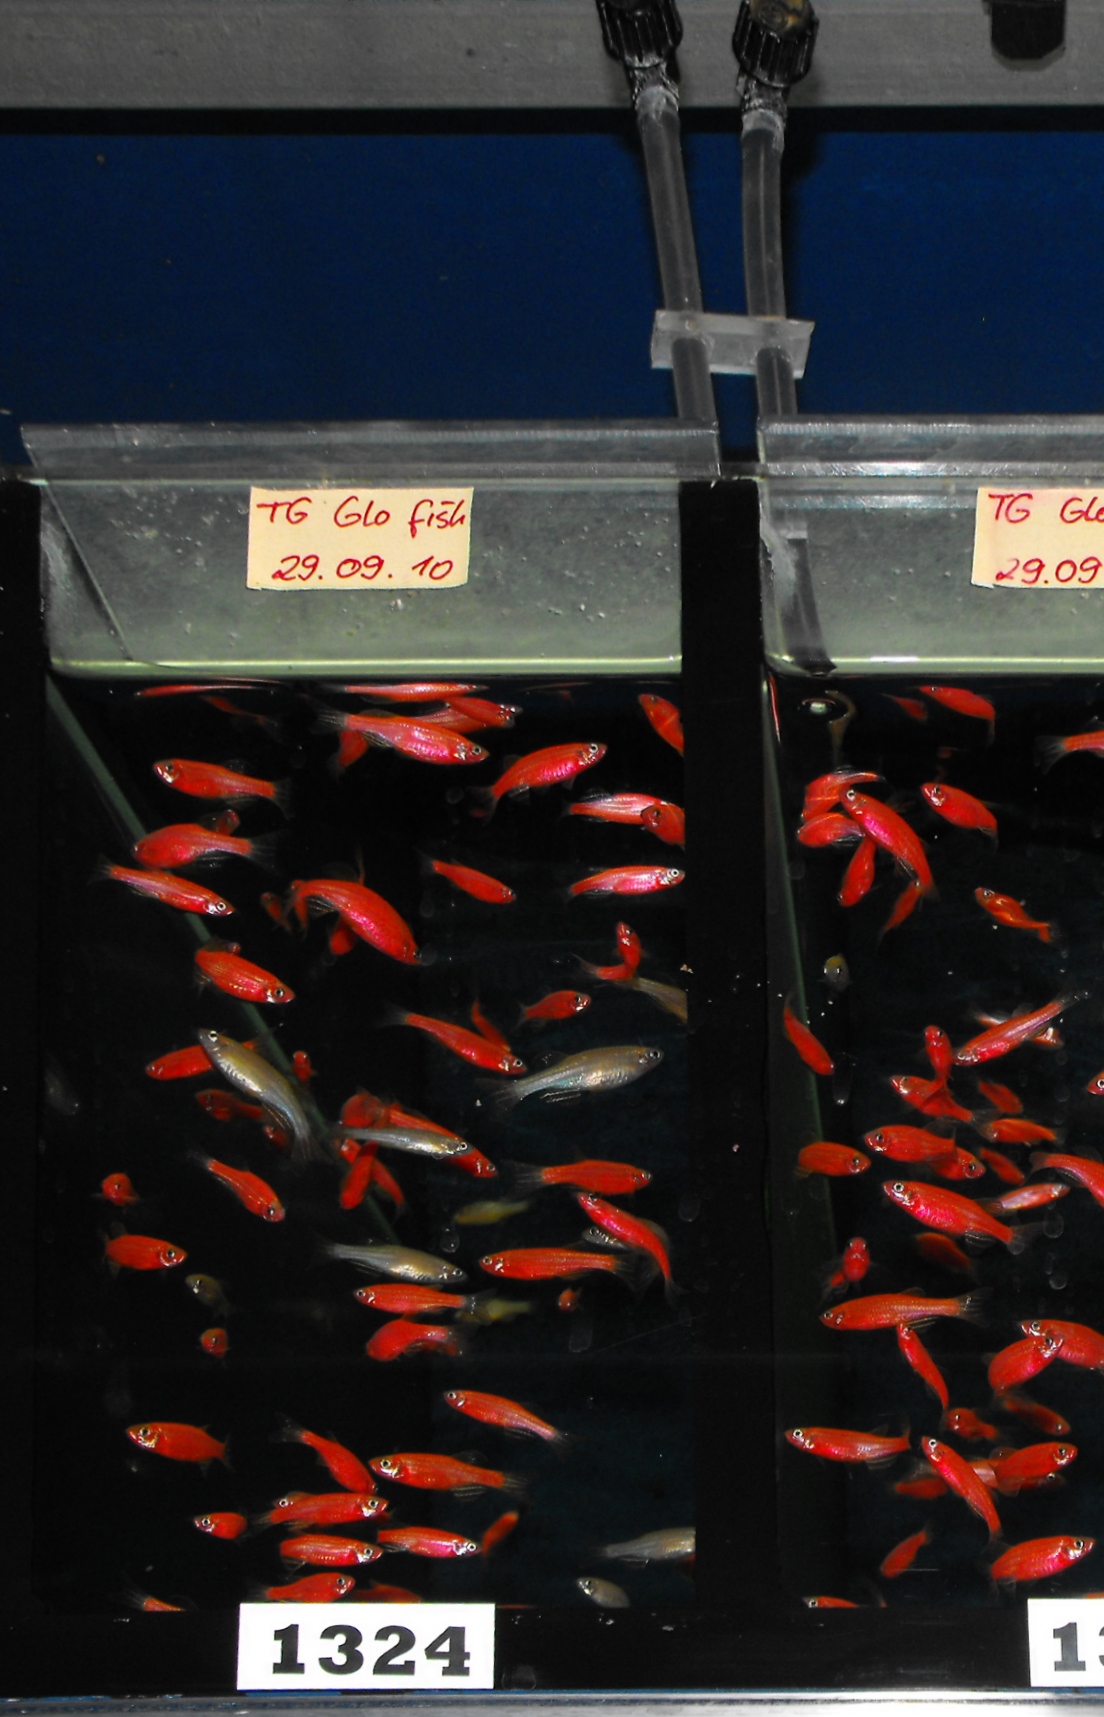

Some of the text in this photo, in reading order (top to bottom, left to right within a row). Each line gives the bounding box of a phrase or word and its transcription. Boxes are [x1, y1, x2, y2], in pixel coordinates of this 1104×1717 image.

[256, 496, 313, 525] TG
[408, 499, 466, 539] fish
[988, 493, 1034, 524] TG
[272, 1623, 471, 1677] 1324
